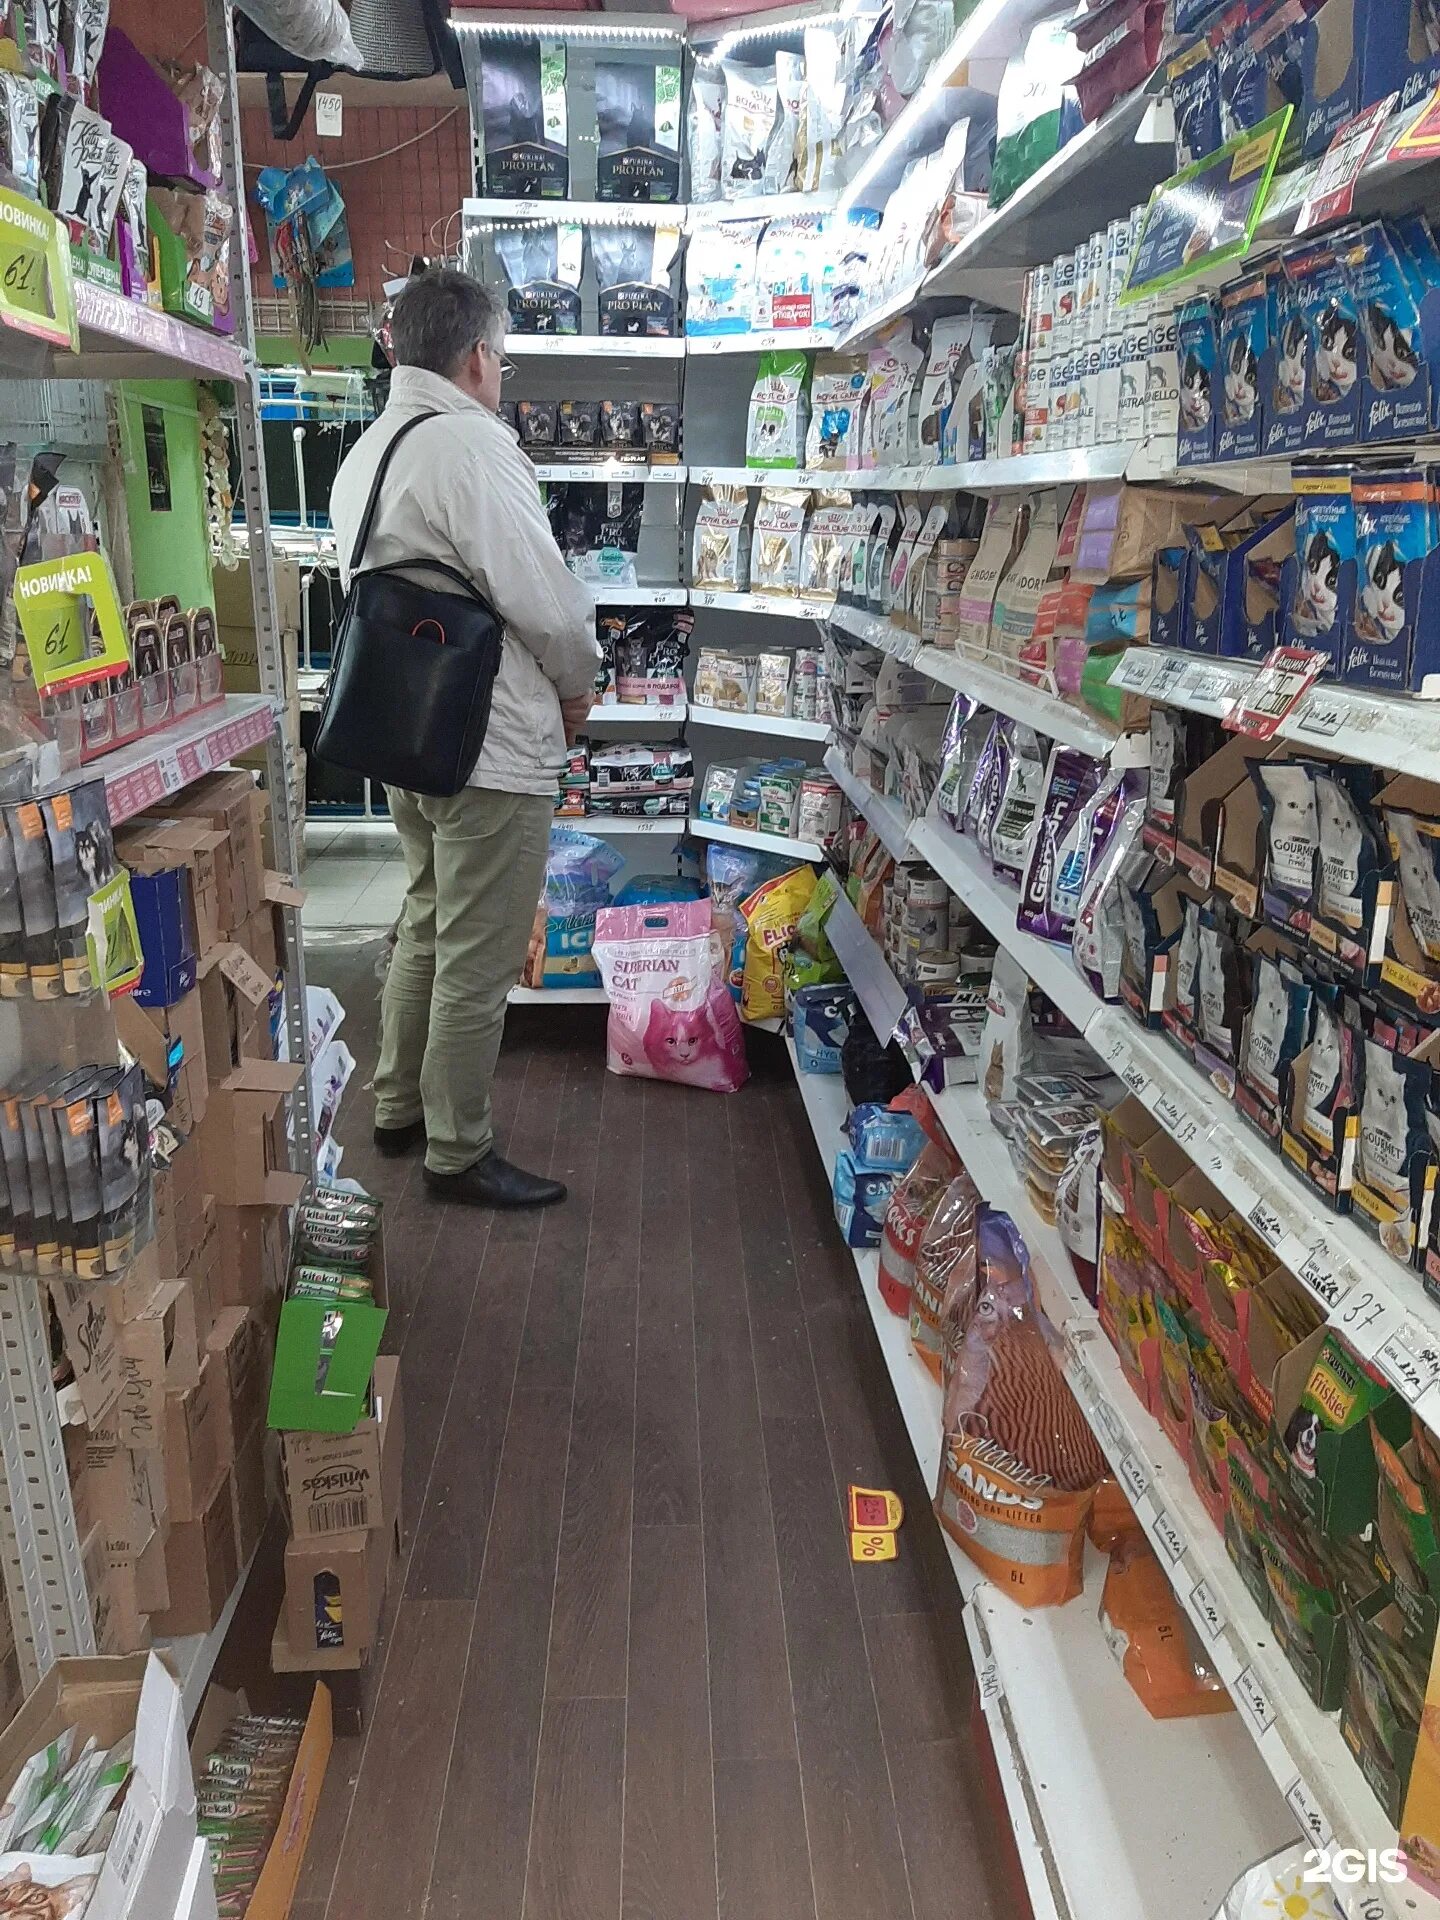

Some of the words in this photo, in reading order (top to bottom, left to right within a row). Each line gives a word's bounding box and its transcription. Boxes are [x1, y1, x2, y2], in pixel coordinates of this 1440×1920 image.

[526, 162, 556, 171] PLAN
[635, 166, 664, 176] PLAN
[0, 205, 50, 242] ОВИНКА!
[19, 565, 92, 600] НОВИНКА!
[44, 618, 71, 655] 61
[1346, 646, 1368, 673] felix
[613, 959, 680, 975] SIBERIAN
[611, 975, 640, 991] CAT
[317, 1190, 350, 1201] kitekat
[307, 1210, 341, 1222] kitekat
[301, 1271, 339, 1284] kitekat
[1343, 1293, 1386, 1332] 37
[1328, 1356, 1356, 1390] PURINA
[1309, 1372, 1346, 1419] Friskies
[301, 1469, 370, 1492] whiskas
[1006, 1508, 1042, 1524] LITTER
